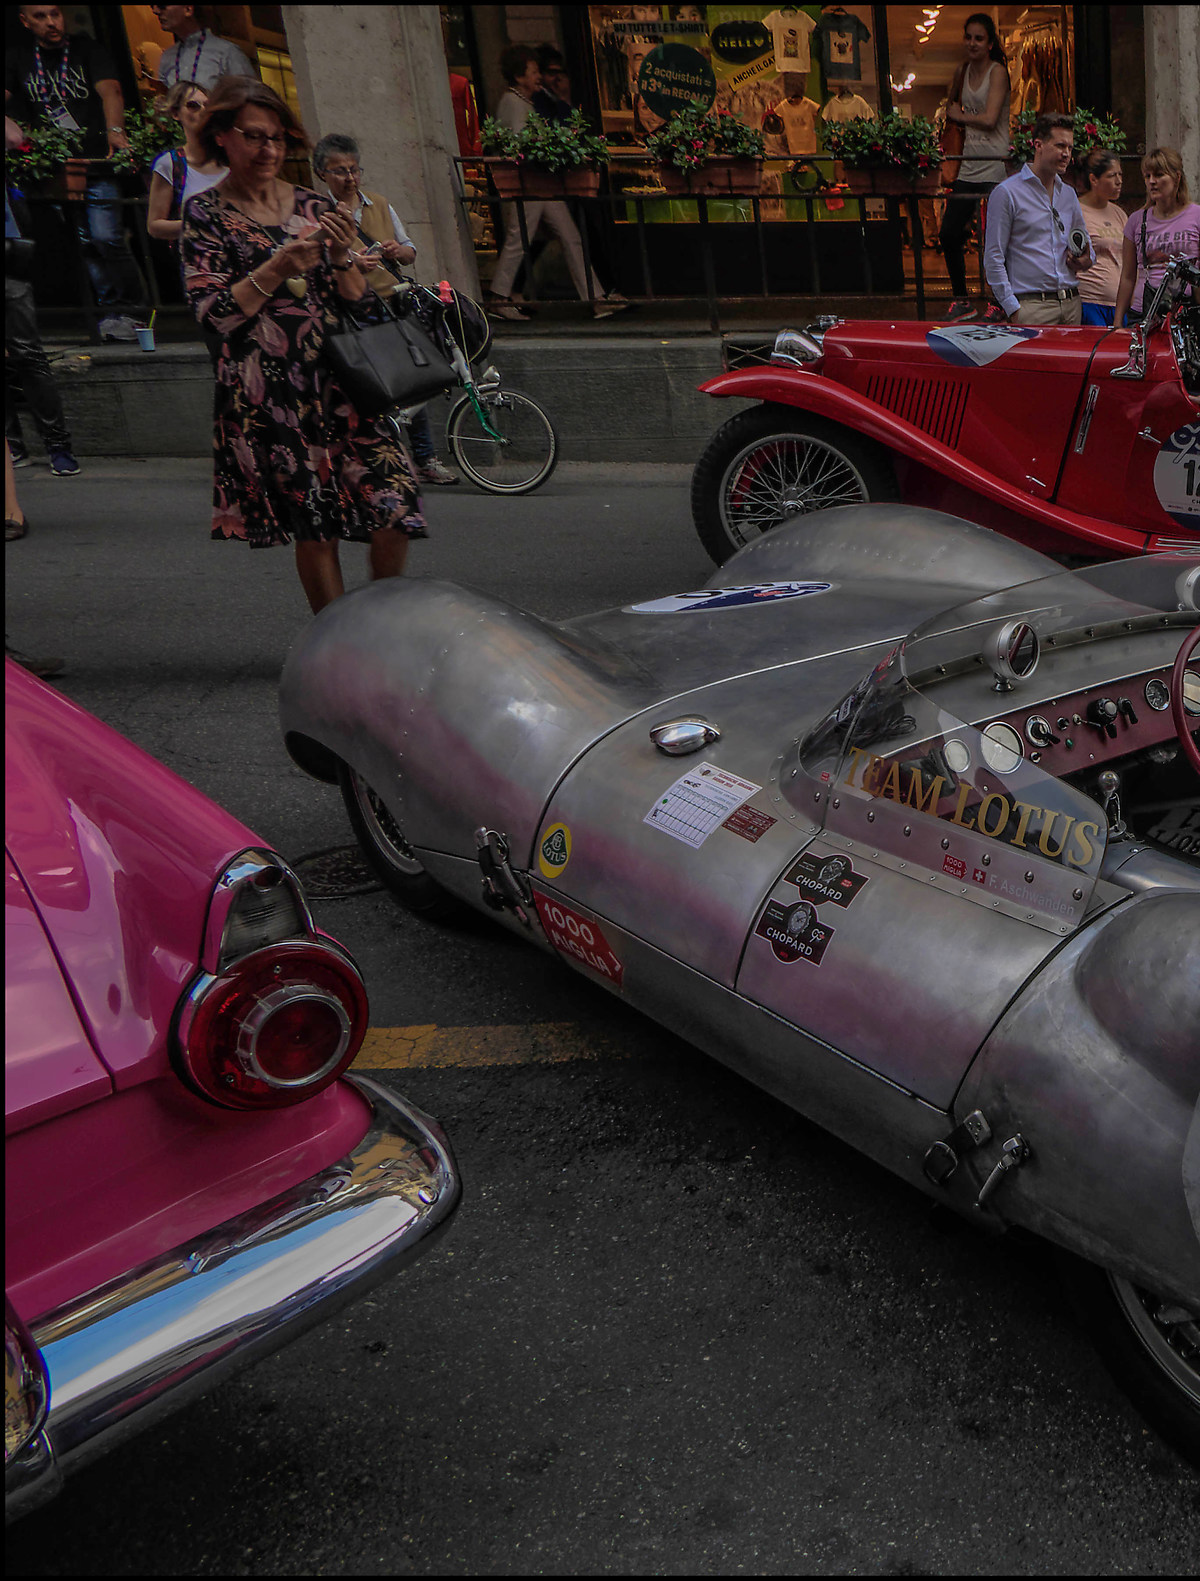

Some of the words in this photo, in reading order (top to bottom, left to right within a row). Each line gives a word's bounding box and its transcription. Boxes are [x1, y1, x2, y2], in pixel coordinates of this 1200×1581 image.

[645, 61, 653, 74] 2
[654, 66, 702, 86] acquistati
[842, 746, 946, 818] TEAM
[951, 782, 1099, 867] LOTUS
[543, 842, 567, 863] LOTUS
[946, 855, 963, 868] 1000
[795, 874, 843, 900] CHOPARD
[544, 903, 595, 946] 1000
[551, 929, 612, 977] MIGLIA
[766, 926, 813, 956] CHOPARD
